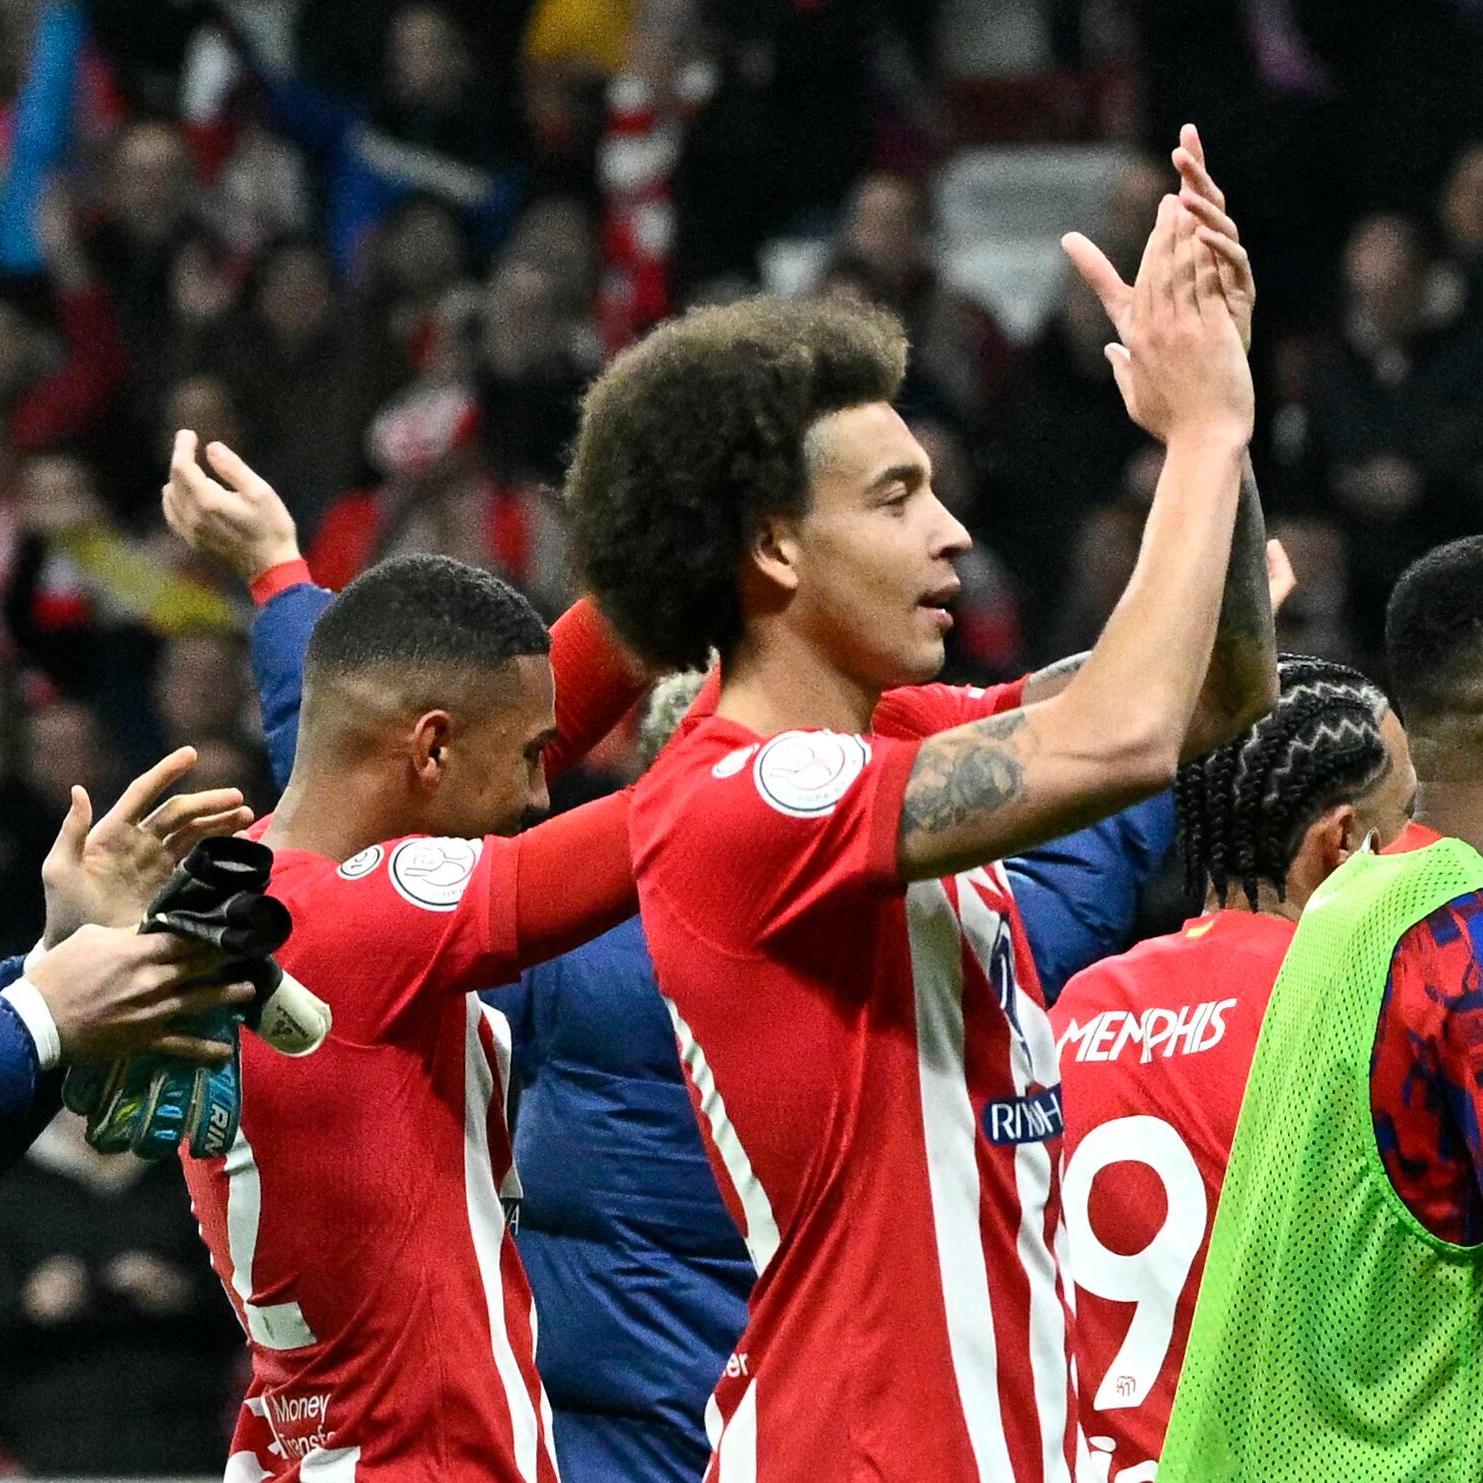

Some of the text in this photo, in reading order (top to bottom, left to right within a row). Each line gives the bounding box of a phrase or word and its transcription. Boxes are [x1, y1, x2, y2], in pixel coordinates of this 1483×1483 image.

[1057, 997, 1238, 1064] MEMPHIS
[1063, 1116, 1207, 1411] 9
[273, 1393, 331, 1424] Money
